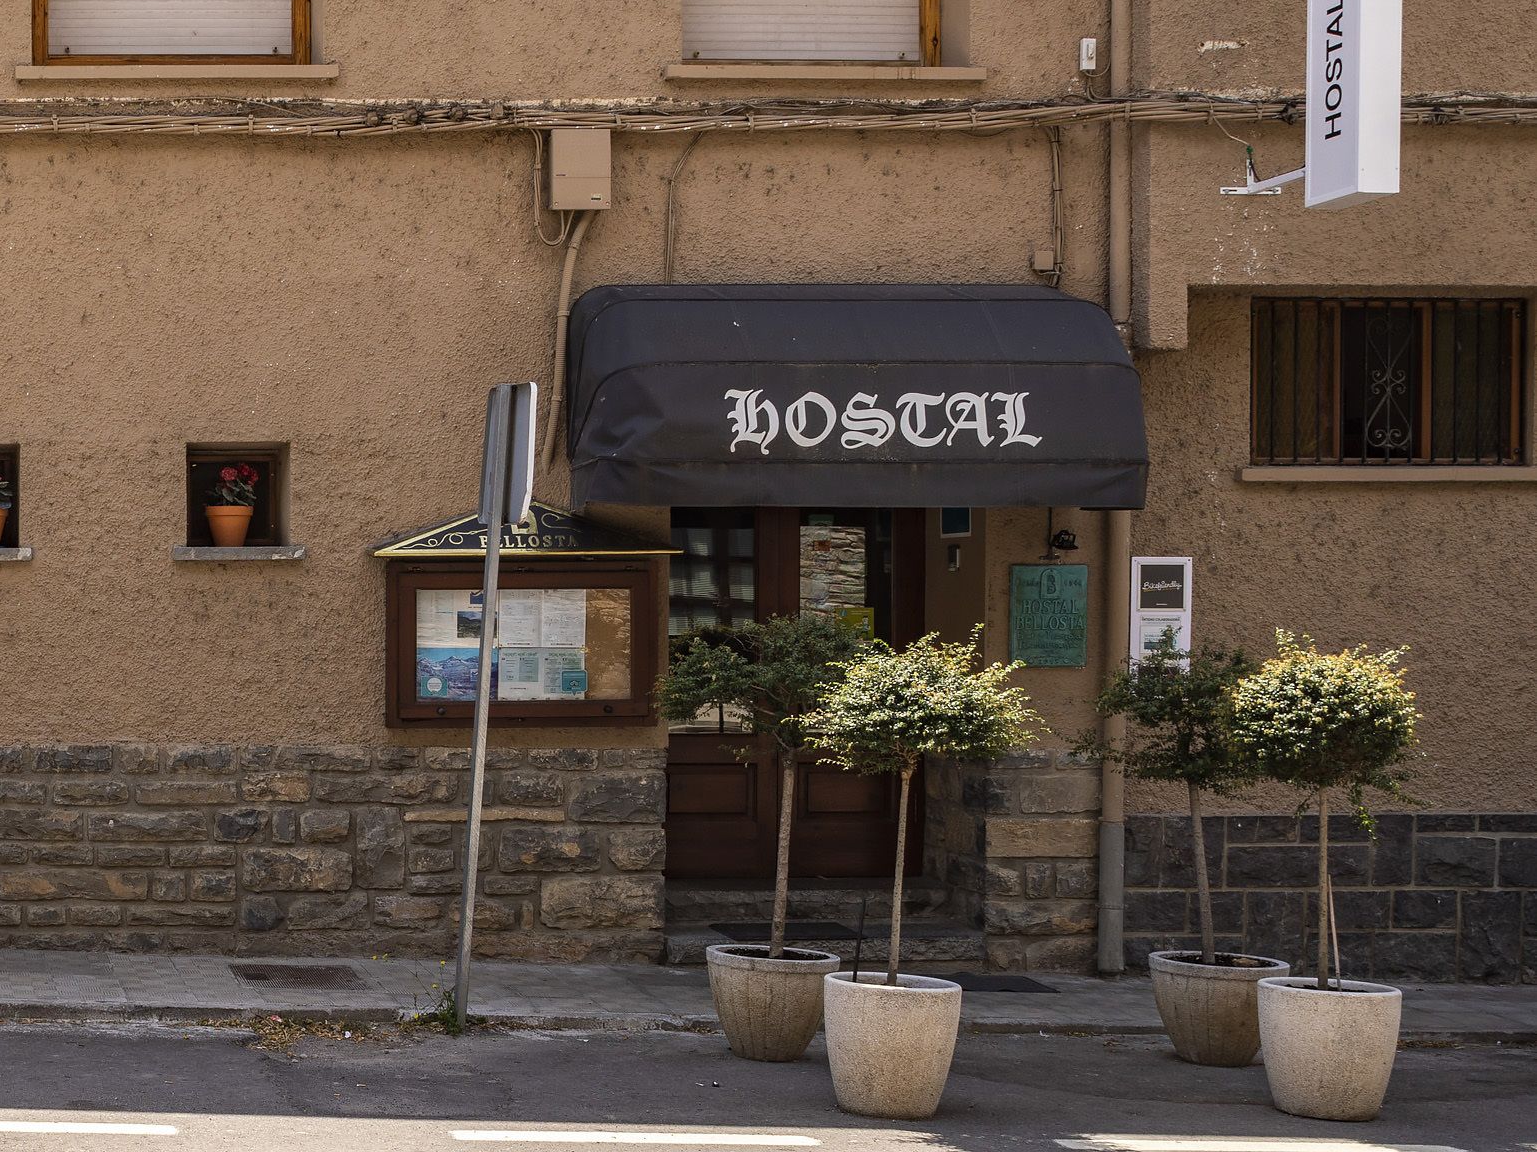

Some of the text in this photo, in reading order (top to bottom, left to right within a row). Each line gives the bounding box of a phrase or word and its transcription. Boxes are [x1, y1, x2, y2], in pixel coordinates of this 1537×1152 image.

[724, 388, 1043, 455] HOSTAL
[479, 534, 578, 548] BLLOSTA
[1022, 599, 1080, 614] HOSTAL
[1015, 614, 1086, 630] BELLOSTA
